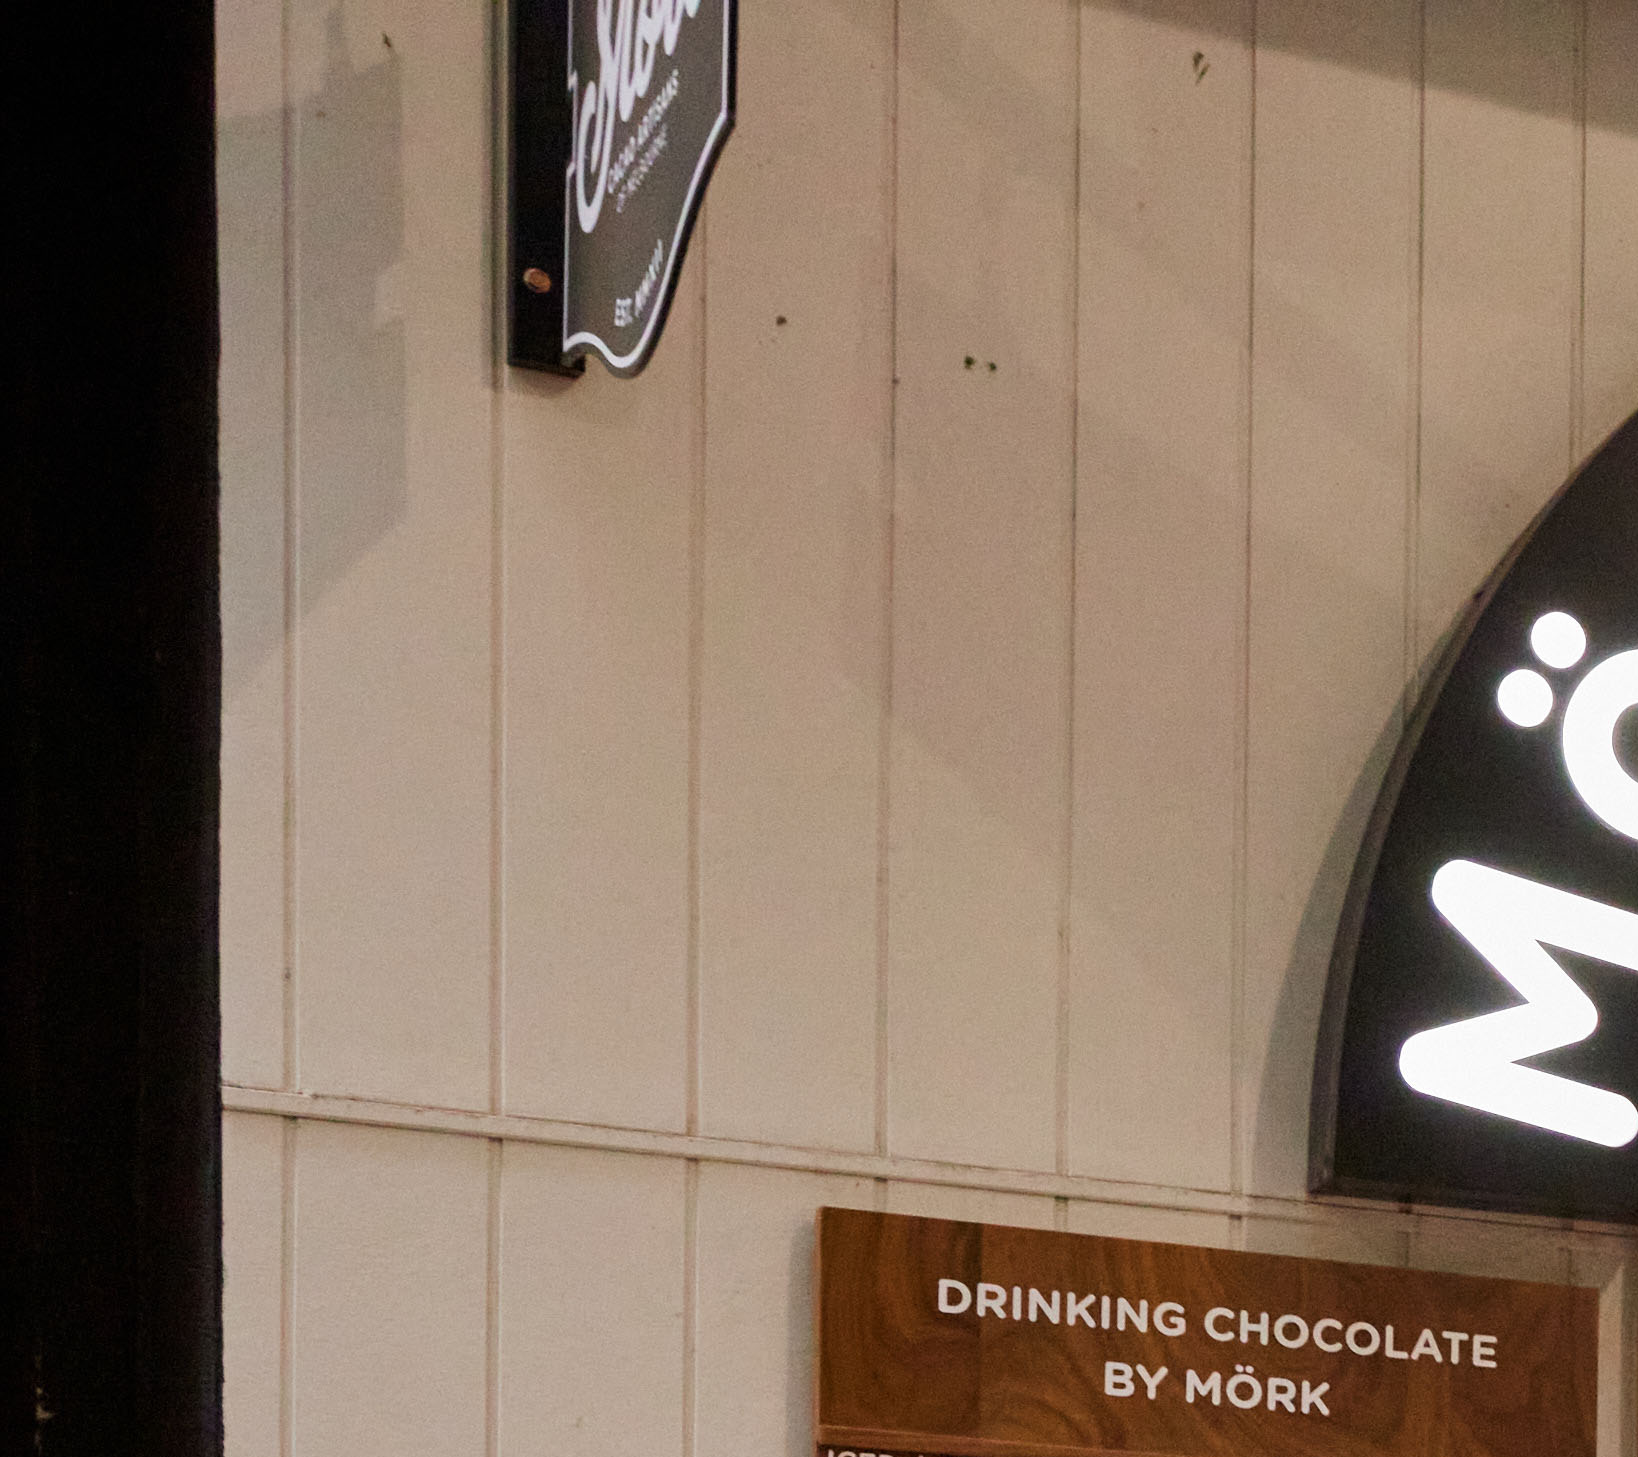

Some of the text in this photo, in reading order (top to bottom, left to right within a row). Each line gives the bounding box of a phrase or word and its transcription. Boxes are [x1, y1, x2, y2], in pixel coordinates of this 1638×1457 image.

[937, 1278, 1498, 1369] DRINKING CHOCOLATE
[1104, 1361, 1330, 1417] BY MÖRK
